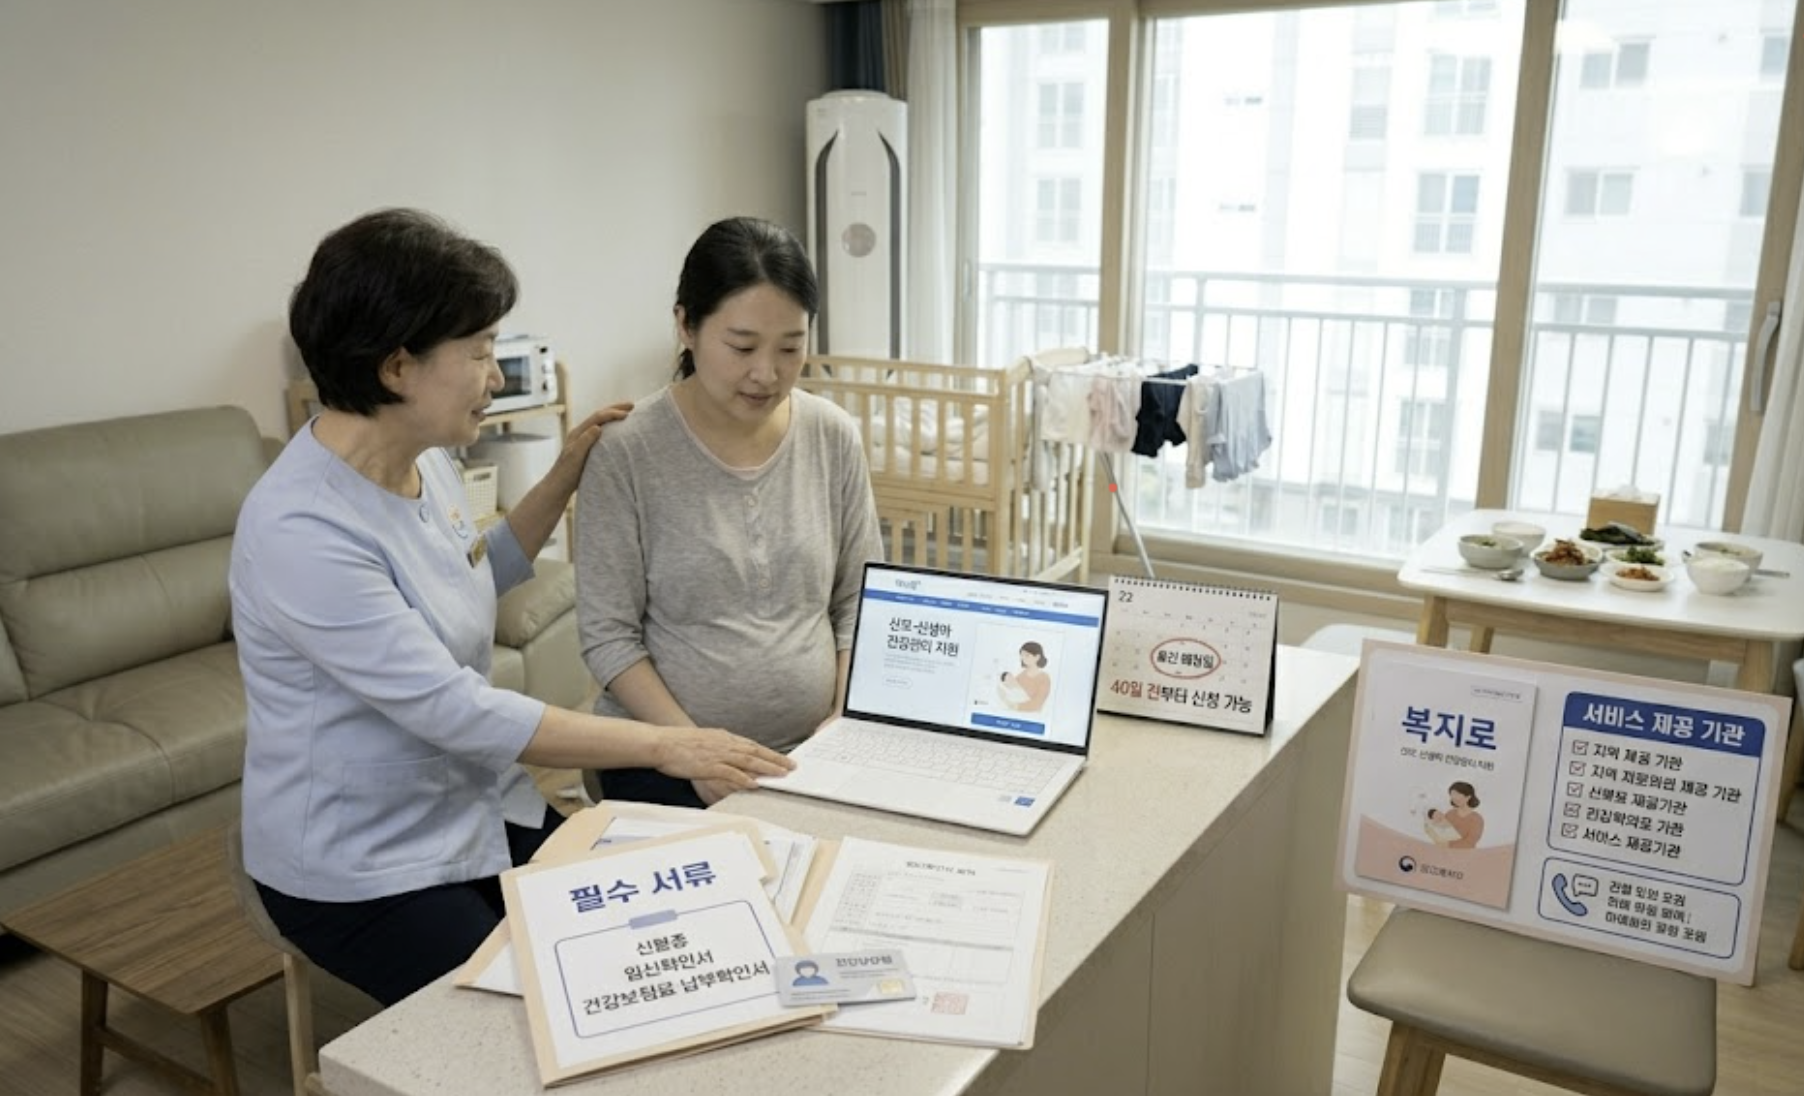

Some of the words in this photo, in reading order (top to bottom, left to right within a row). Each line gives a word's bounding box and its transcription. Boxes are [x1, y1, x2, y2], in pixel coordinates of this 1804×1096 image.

[1191, 690, 1219, 709] 신청
[1224, 695, 1252, 713] 가능
[1402, 706, 1497, 750] 복지로
[1583, 703, 1645, 731] 서비스
[1652, 712, 1694, 738] 제공
[1701, 719, 1746, 746] 기관
[1656, 754, 1683, 772] 기관
[569, 879, 640, 913] 필수
[652, 861, 716, 894] 서류
